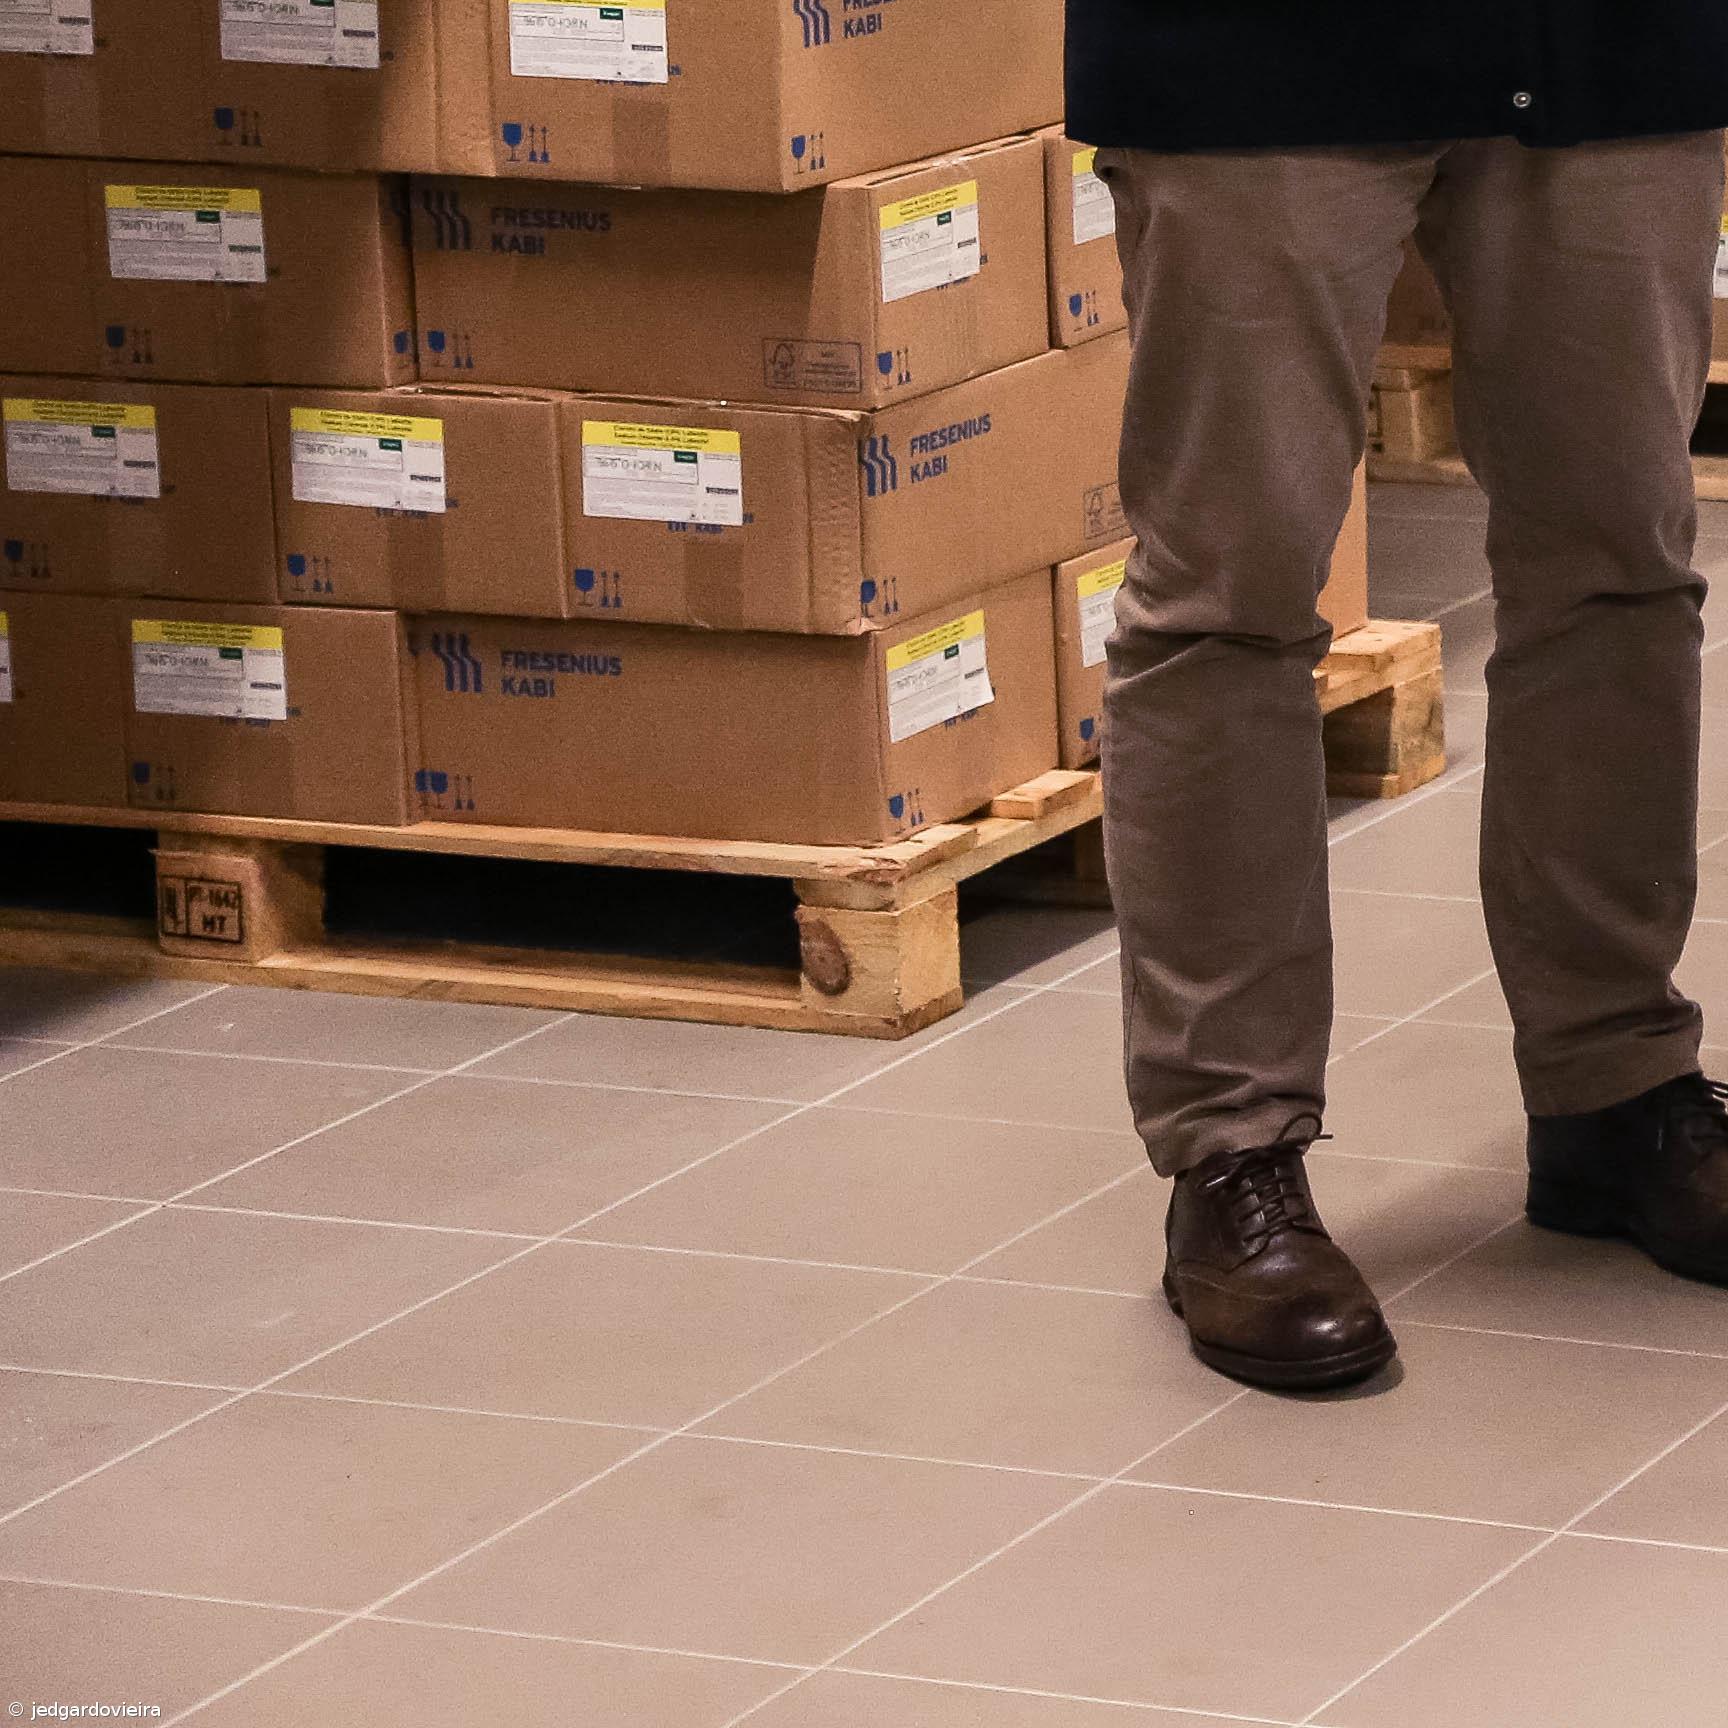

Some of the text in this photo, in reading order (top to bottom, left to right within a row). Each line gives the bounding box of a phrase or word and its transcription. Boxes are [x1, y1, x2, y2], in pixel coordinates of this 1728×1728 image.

[843, 14, 883, 39] KABI
[490, 206, 612, 234] FRESENIUS
[491, 233, 545, 256] KABI
[909, 413, 992, 454] FRESENIUS
[910, 458, 948, 484] KABI
[501, 651, 622, 678] FRESENIUS
[501, 677, 556, 699] KABI
